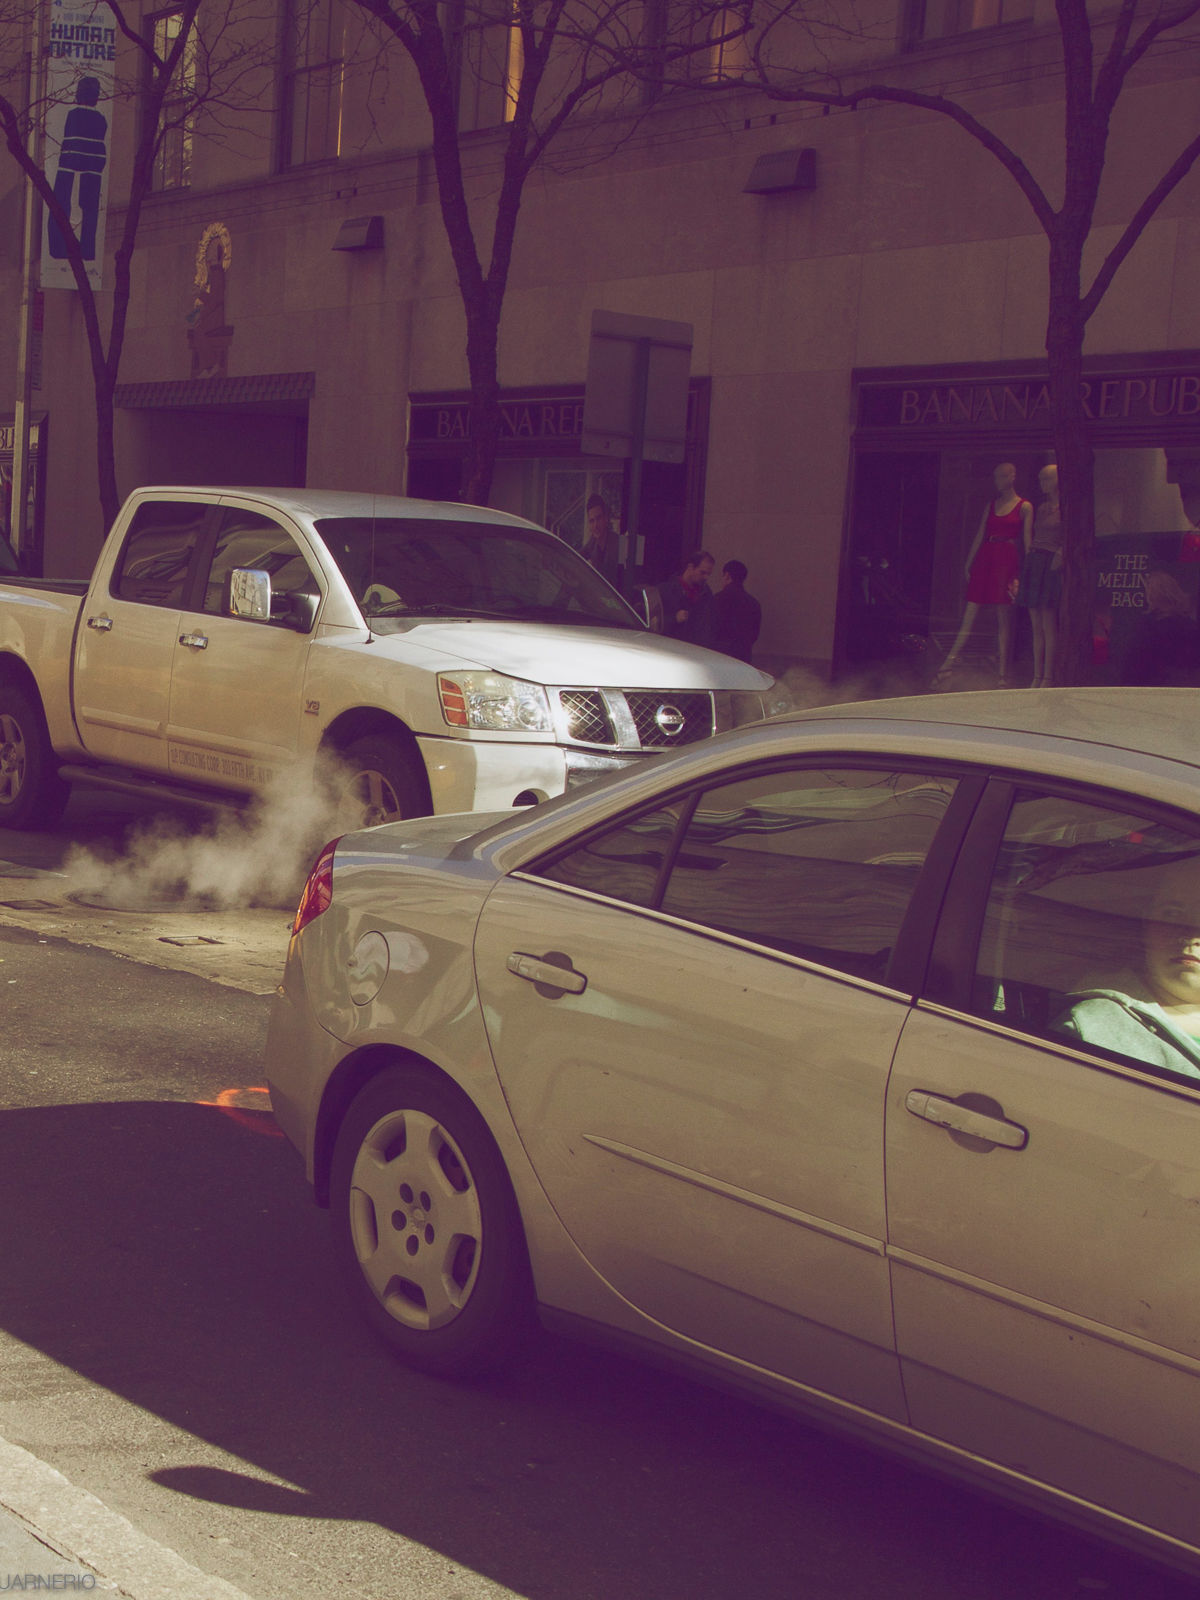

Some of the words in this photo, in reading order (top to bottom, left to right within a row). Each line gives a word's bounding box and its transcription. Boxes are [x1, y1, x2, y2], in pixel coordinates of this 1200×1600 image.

[51, 23, 115, 44] HUMAN
[49, 41, 116, 61] NATURE
[900, 385, 1050, 424] BANANA
[437, 406, 534, 438] BANA
[541, 404, 585, 436] REP
[1114, 554, 1149, 570] THE
[1097, 572, 1150, 588] MELIN
[1110, 591, 1145, 608] BAG
